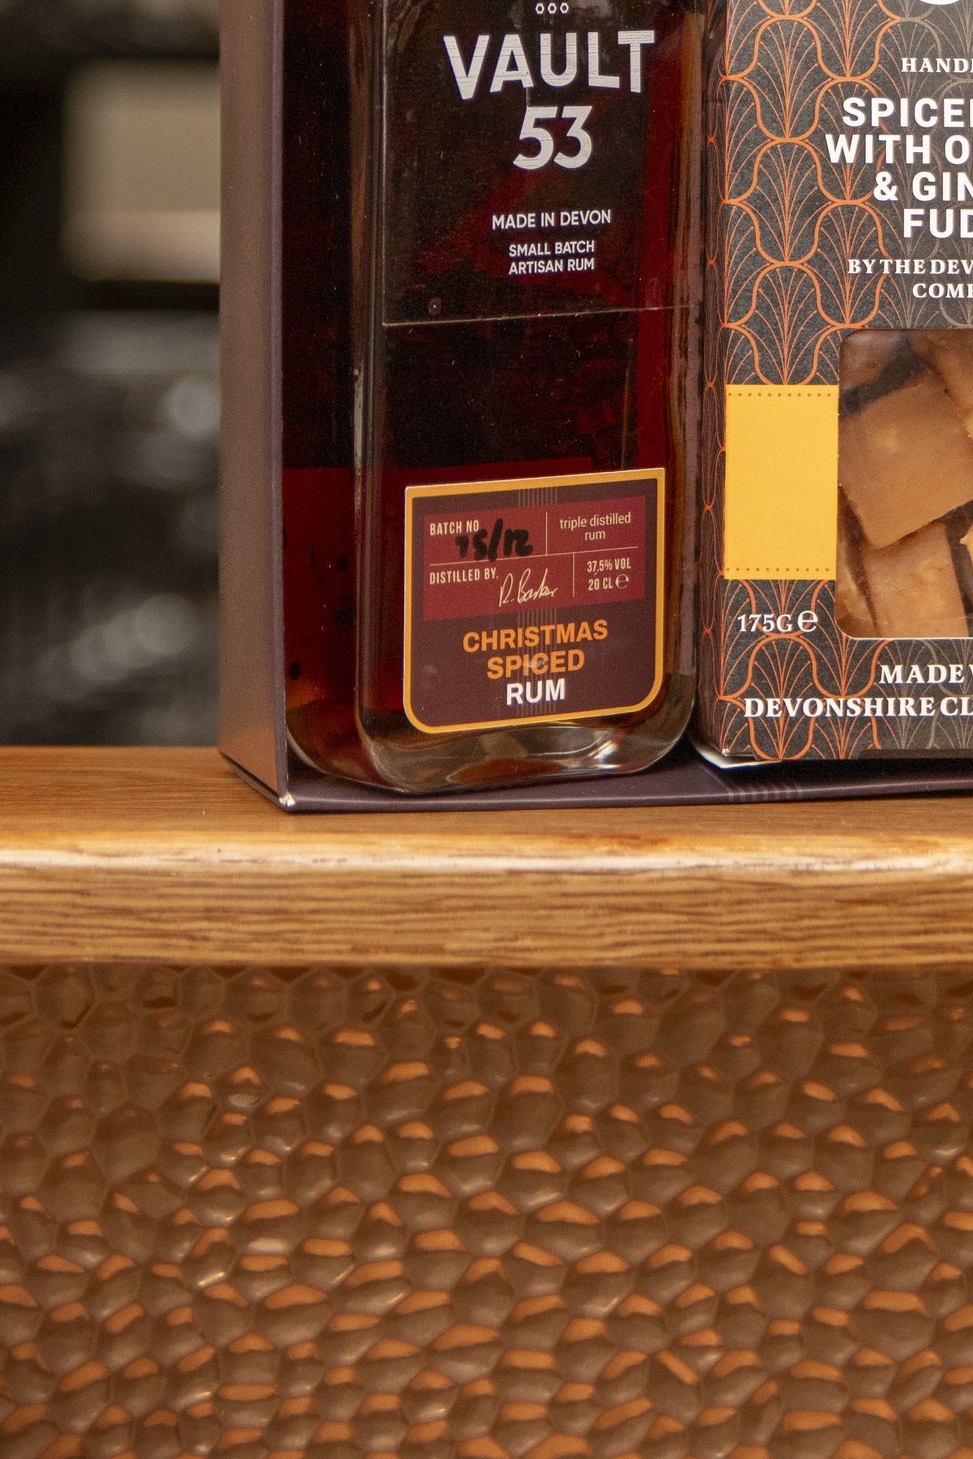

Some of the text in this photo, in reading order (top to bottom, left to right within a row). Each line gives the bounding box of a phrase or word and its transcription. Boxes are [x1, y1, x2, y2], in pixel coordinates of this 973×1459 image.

[443, 30, 655, 100] VAULT
[512, 105, 593, 171] 53
[825, 134, 931, 165] WITH
[873, 172, 898, 201] &
[491, 209, 611, 230] MADE IN DEVON
[508, 240, 595, 257] SMALL BATCH
[508, 258, 595, 275] ARTISAN RUM
[848, 258, 878, 274] BY
[880, 258, 924, 275] THE
[429, 519, 480, 536] BATCH NO
[559, 511, 632, 532] triple distilled
[584, 530, 606, 541] rum
[586, 557, 632, 574] 37.5% VOL
[429, 567, 500, 585] DISTILLED BY.
[587, 577, 601, 592] 20
[602, 576, 614, 591] CL
[737, 614, 793, 633] 175G
[462, 619, 609, 654] CHRISTMAS
[486, 649, 585, 680] SPICED
[878, 665, 964, 684] MADE
[506, 678, 566, 706] RUM
[743, 698, 936, 718] DEVONSHIRE
